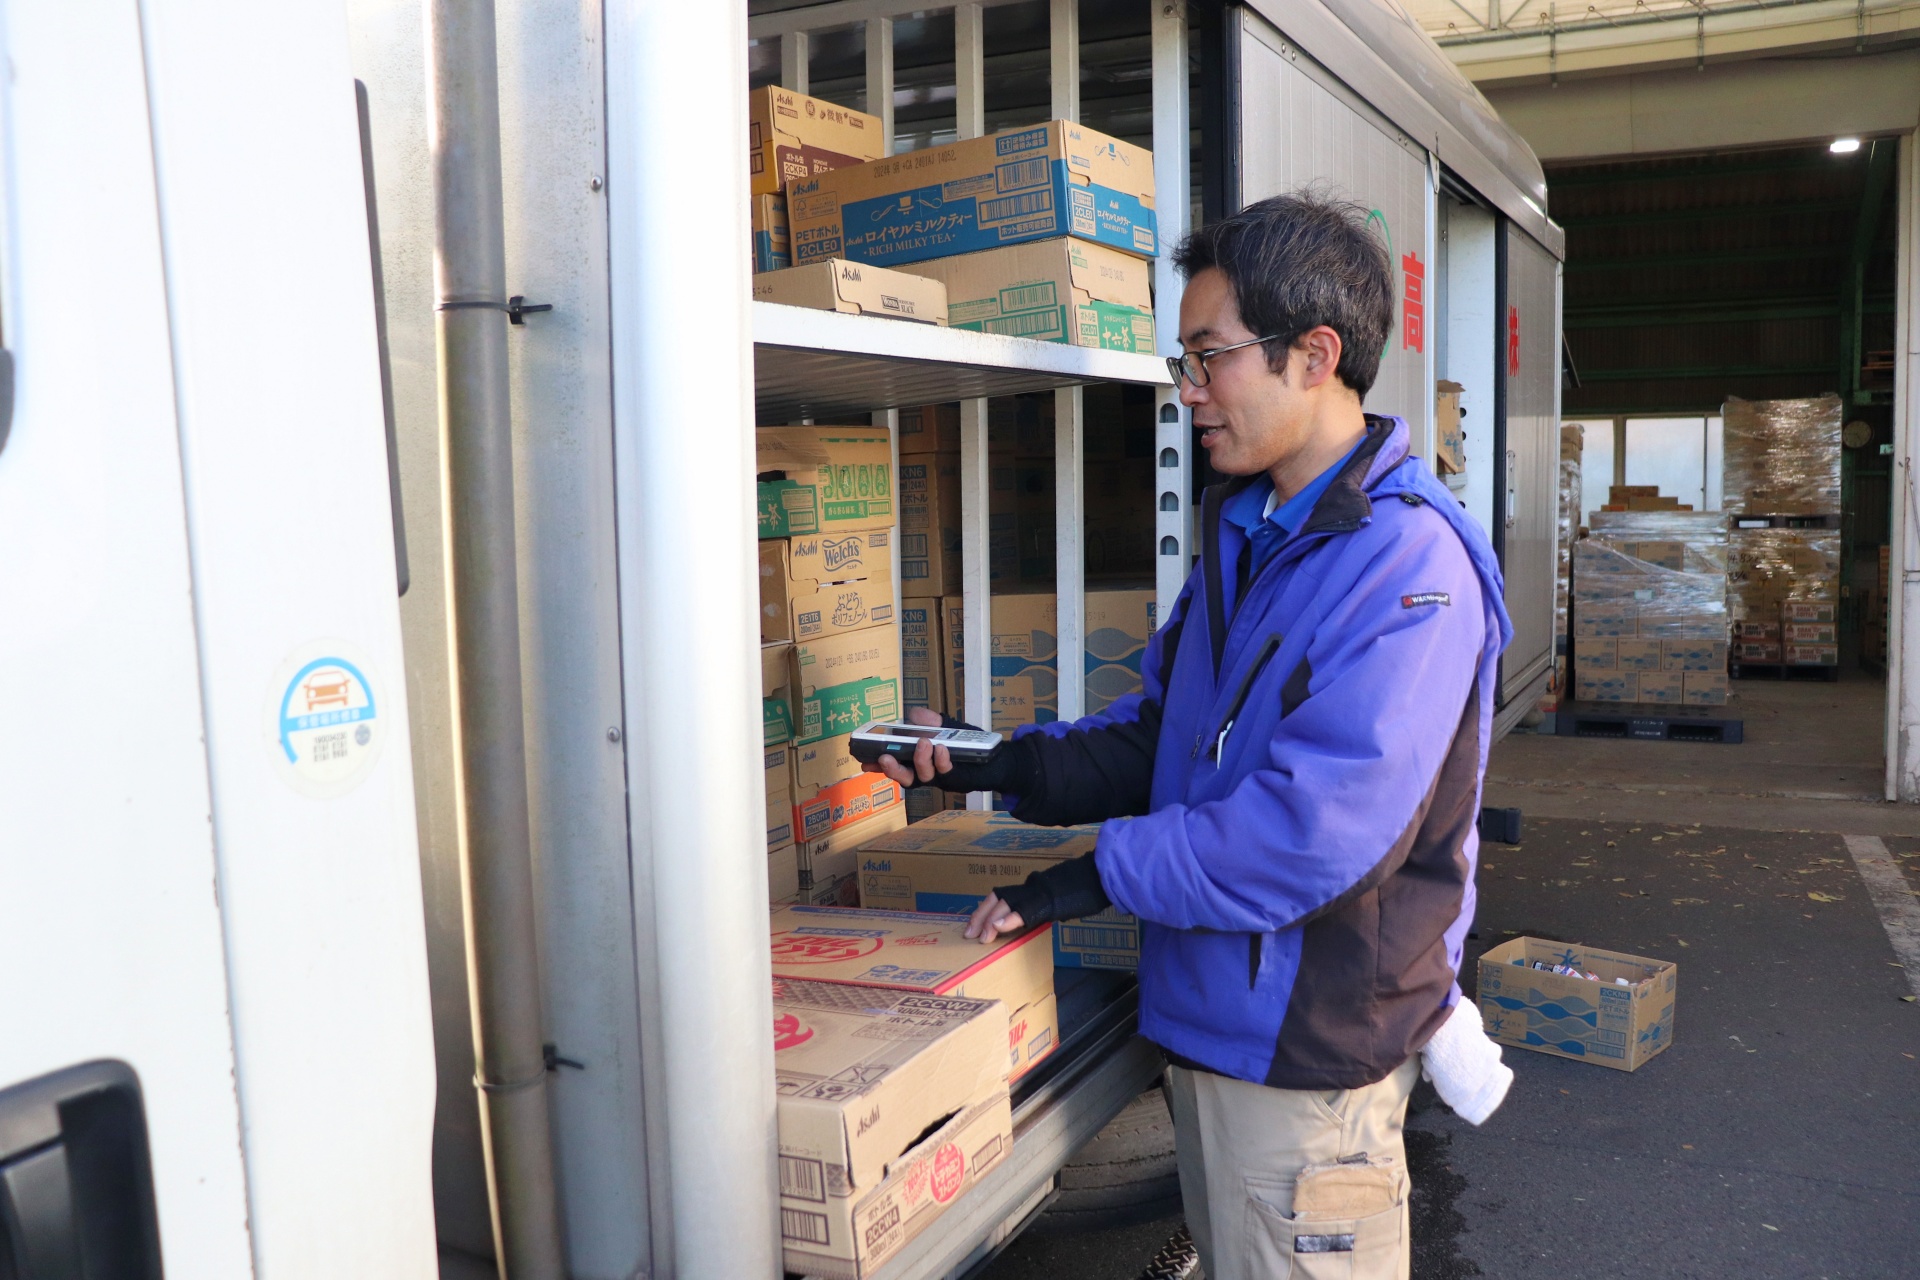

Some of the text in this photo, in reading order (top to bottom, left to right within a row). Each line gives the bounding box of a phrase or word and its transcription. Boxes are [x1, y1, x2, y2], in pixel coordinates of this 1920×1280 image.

[777, 94, 793, 106] Asahi
[793, 181, 819, 196] Asahi
[796, 224, 840, 242] PETボトル
[846, 213, 973, 247] Asahi ロイヤルミルクティー
[869, 233, 951, 257] RICH MILKY TEA
[842, 267, 862, 282] Asahi
[1402, 251, 1425, 354] 高
[1102, 326, 1131, 352] 十六茶
[795, 540, 860, 567] Asahi Welch's
[835, 592, 860, 611] ぶどう
[832, 608, 868, 625] ポリフェノール
[1000, 696, 1026, 706] 天然水
[826, 701, 864, 731] 十六茶
[803, 750, 817, 762] Asahi
[815, 840, 830, 856] Asahi
[863, 859, 892, 872] Asahi
[887, 1016, 945, 1027] ボトル缶
[857, 1104, 881, 1138] Asahi
[938, 1173, 961, 1201] ストロング
[866, 1208, 899, 1244] 2CCW4
